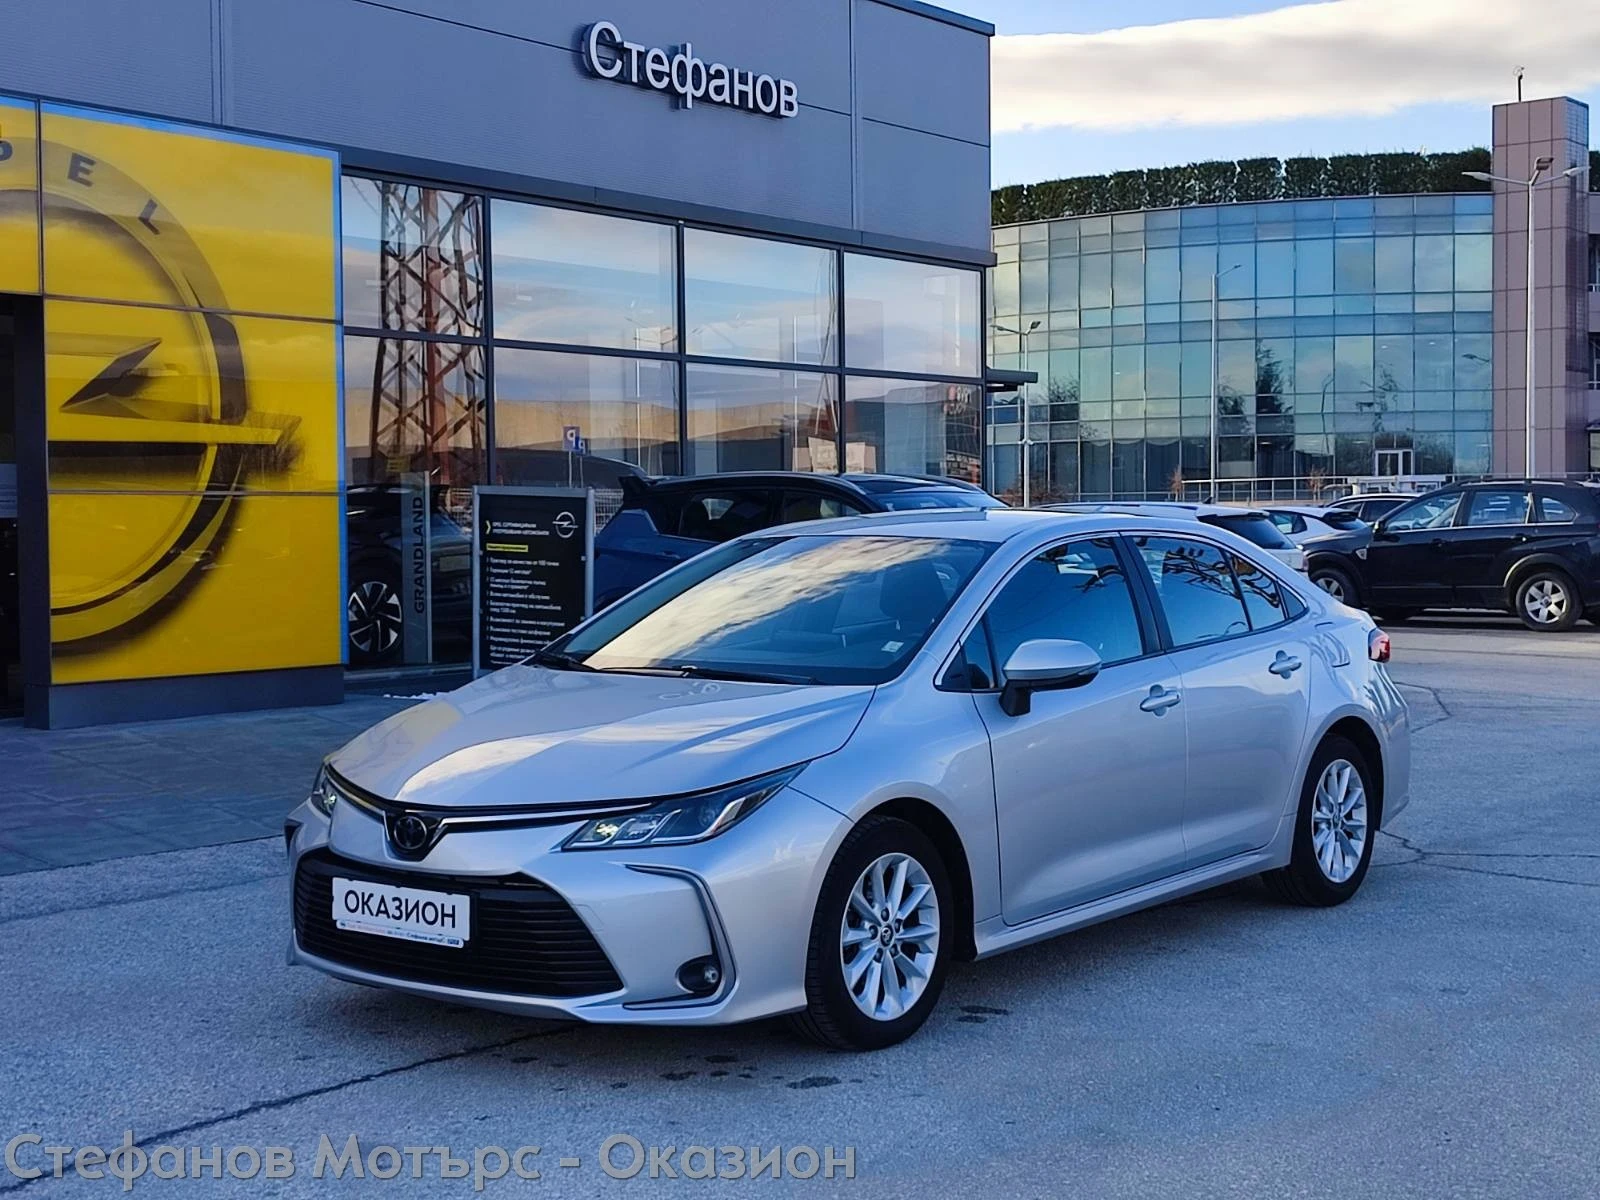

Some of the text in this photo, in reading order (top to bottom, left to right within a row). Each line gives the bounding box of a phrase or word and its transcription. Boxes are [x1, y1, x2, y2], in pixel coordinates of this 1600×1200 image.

[589, 20, 799, 119] Стефанов
[412, 496, 425, 614] GRANDLAND
[344, 889, 456, 929] ОКАЗИОН
